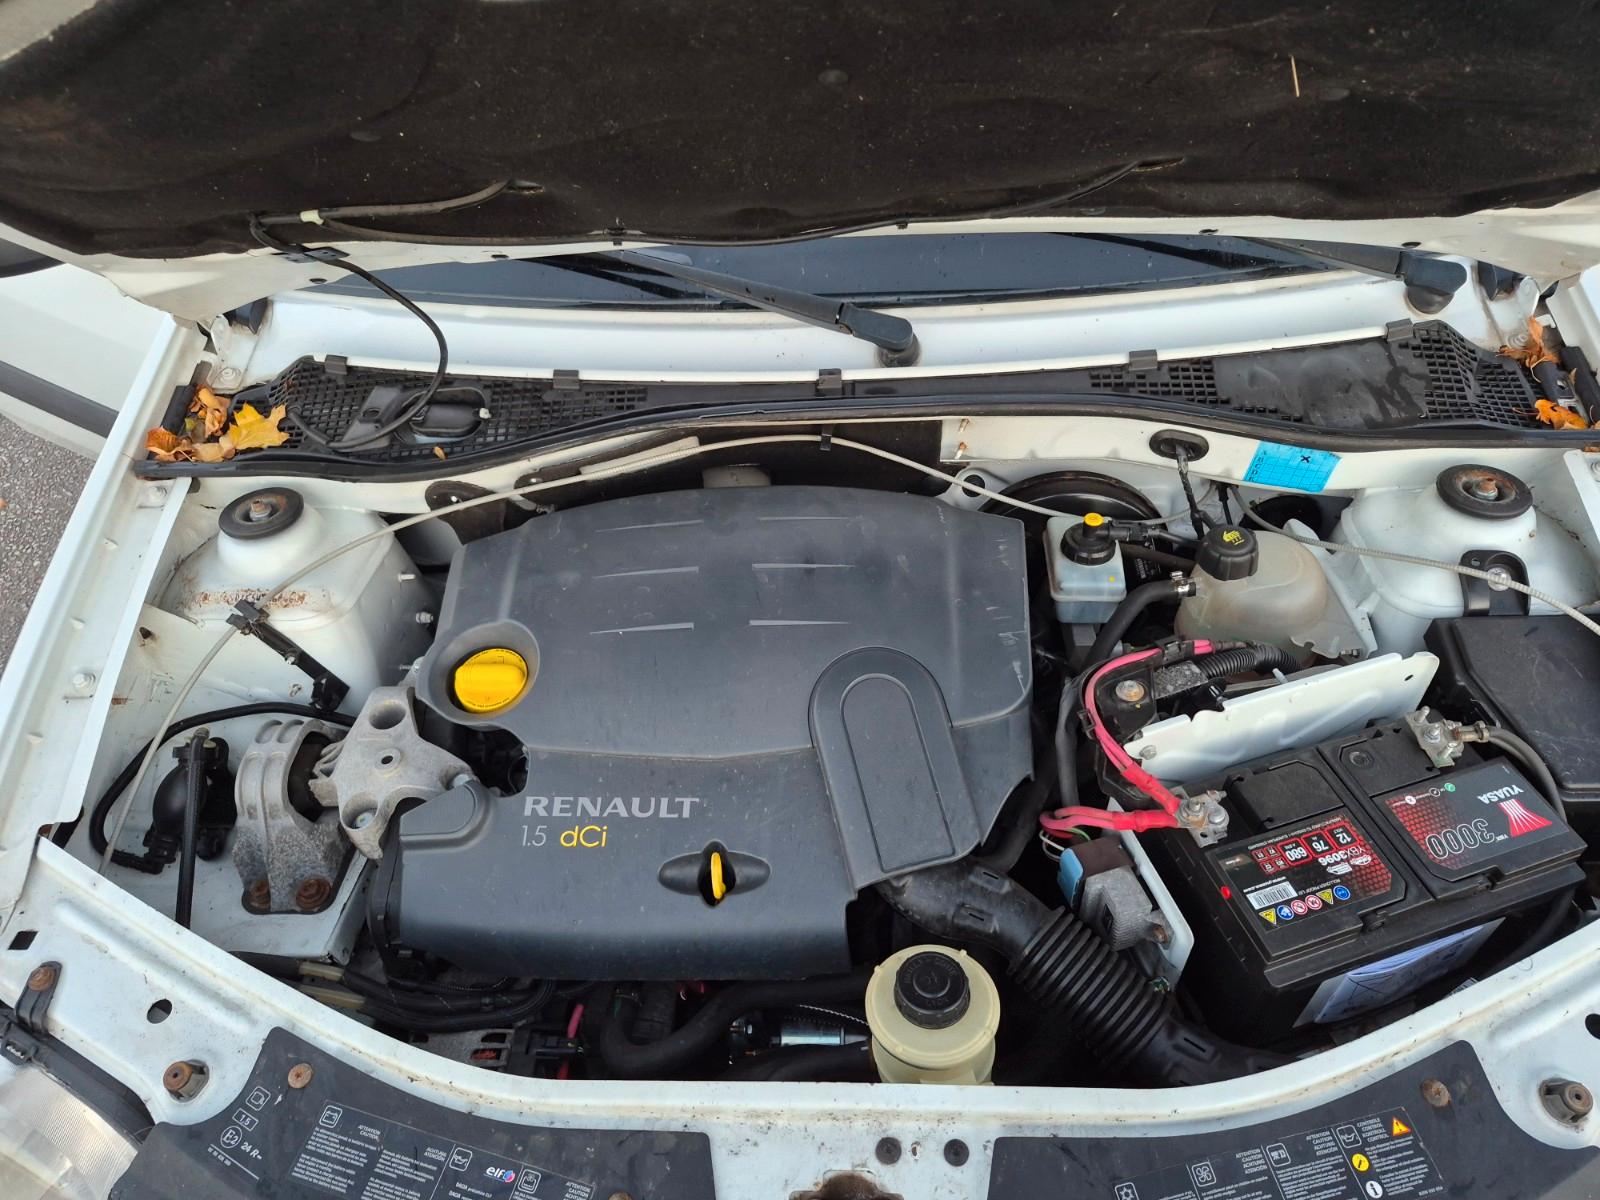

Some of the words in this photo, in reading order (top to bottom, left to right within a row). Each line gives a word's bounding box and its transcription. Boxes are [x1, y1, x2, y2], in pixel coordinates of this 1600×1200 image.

[1476, 783, 1523, 805] YUASA
[524, 796, 700, 818] RENAULT
[521, 825, 547, 847] 1.5
[560, 825, 608, 848] dCi
[1335, 831, 1352, 844] 12
[1424, 817, 1495, 860] 3000
[1285, 846, 1306, 860] 680
[1311, 839, 1328, 852] 76
[1317, 845, 1364, 866] YBX3096
[240, 1141, 252, 1152] 24
[485, 1164, 505, 1178] elf
